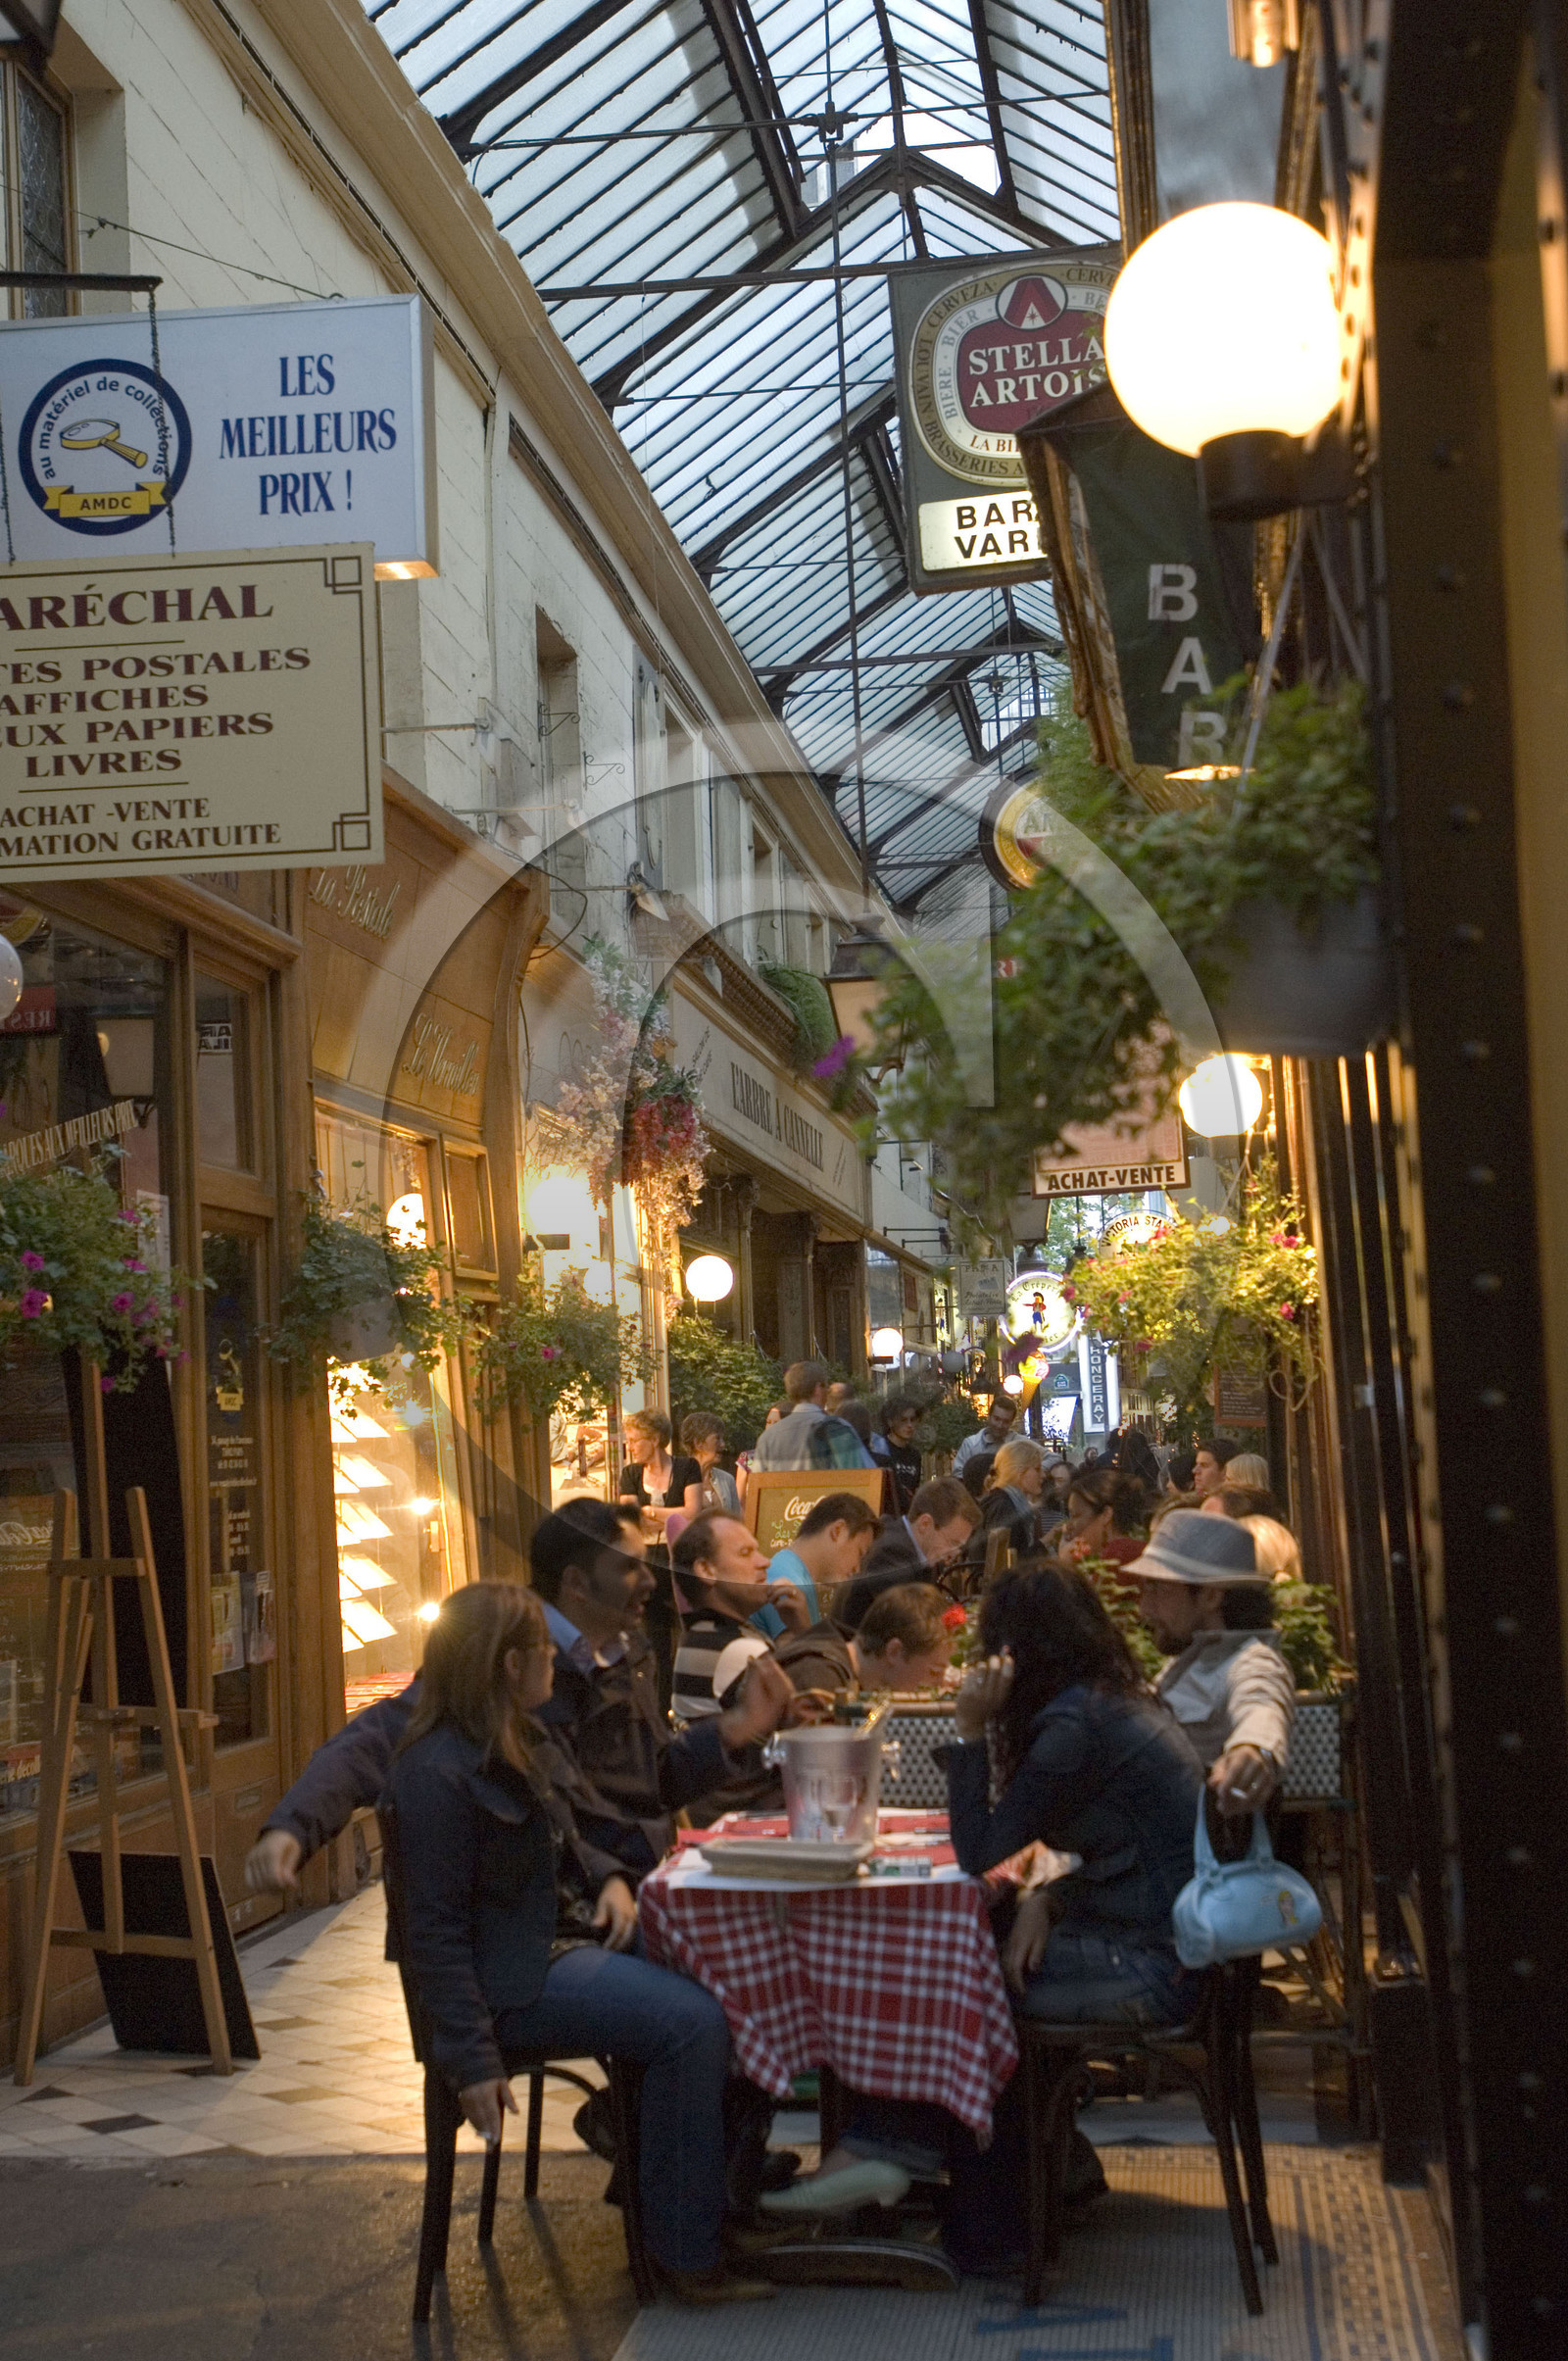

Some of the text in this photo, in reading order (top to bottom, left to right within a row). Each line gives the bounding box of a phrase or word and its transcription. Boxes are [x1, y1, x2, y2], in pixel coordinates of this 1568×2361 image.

[942, 309, 979, 347] BIER
[968, 336, 1107, 376] STELLA
[279, 354, 335, 397] LES
[969, 364, 1108, 408] ARTOIS
[38, 376, 170, 480] au matériel de collections
[220, 409, 398, 459] MEILLEURS
[969, 435, 991, 452] LA
[924, 422, 1008, 475] BRASSERIES
[79, 496, 132, 511] AMDC
[259, 471, 335, 516] PRIX
[956, 499, 1033, 530] BAR
[955, 529, 1029, 559] VAR
[82, 647, 311, 681] POSTALES
[1148, 564, 1228, 768] BAR
[0, 684, 209, 716] AFFICHES
[0, 713, 274, 748] UX PAPIERS
[25, 749, 182, 778] LIVRES
[1, 804, 95, 827] ACHAT
[0, 823, 281, 859] MATION GRATUITE
[731, 1061, 773, 1135] L'ARBRE
[784, 1105, 824, 1172] CANNELLE
[1048, 1165, 1175, 1191] ACHAT-VENTE
[1101, 1215, 1140, 1248] VICTORIA
